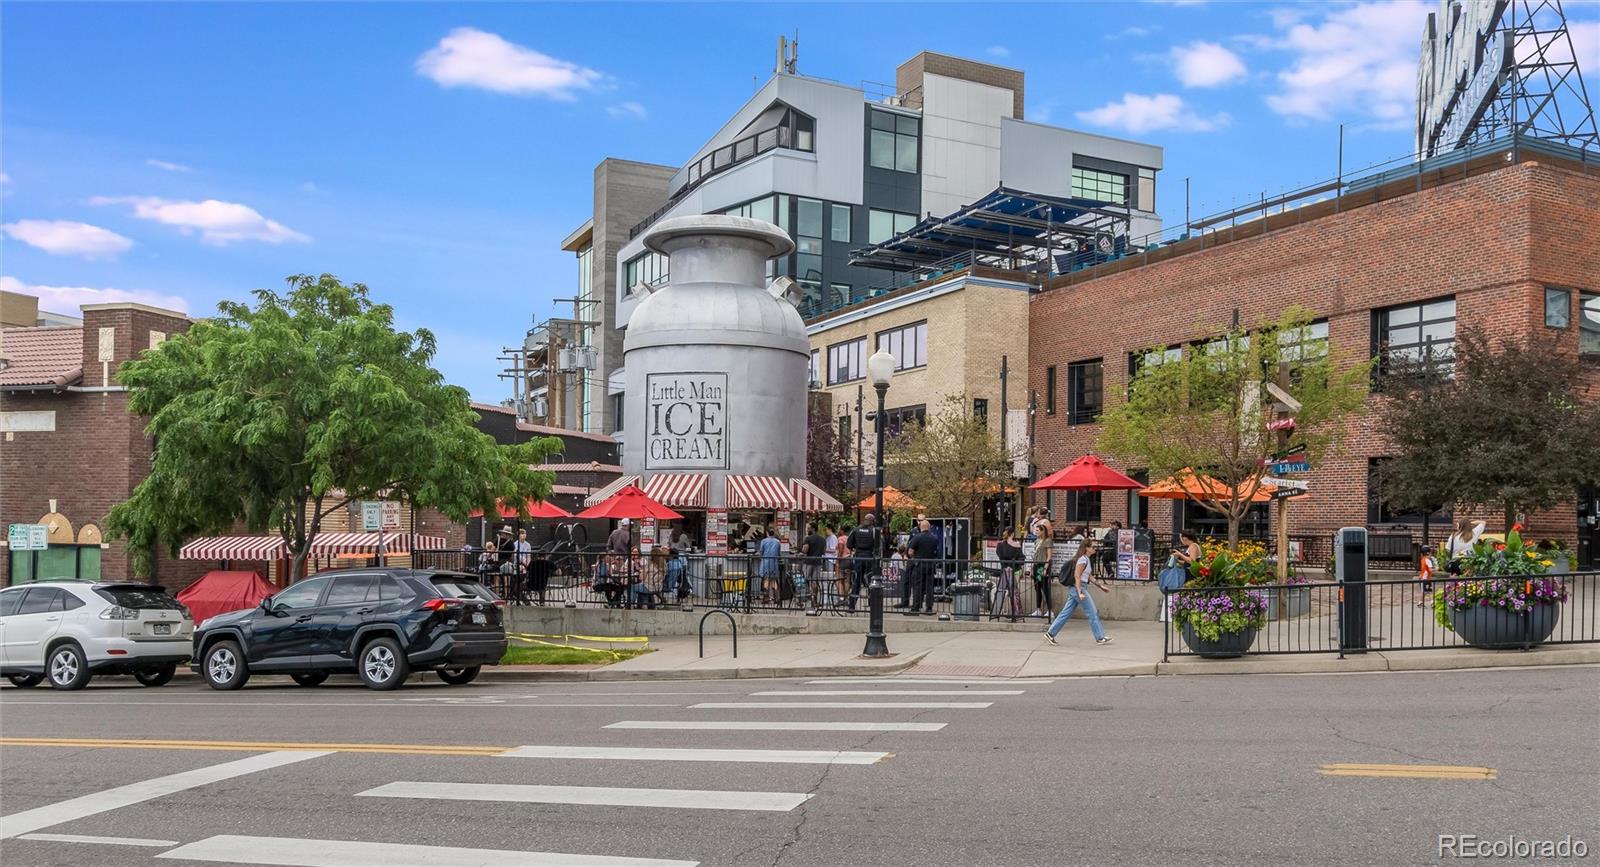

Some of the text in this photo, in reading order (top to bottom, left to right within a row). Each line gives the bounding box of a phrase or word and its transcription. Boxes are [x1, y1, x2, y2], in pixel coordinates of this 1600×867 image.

[652, 380, 722, 400] Little Man
[651, 401, 722, 436] ICE
[650, 437, 722, 460] CREAM
